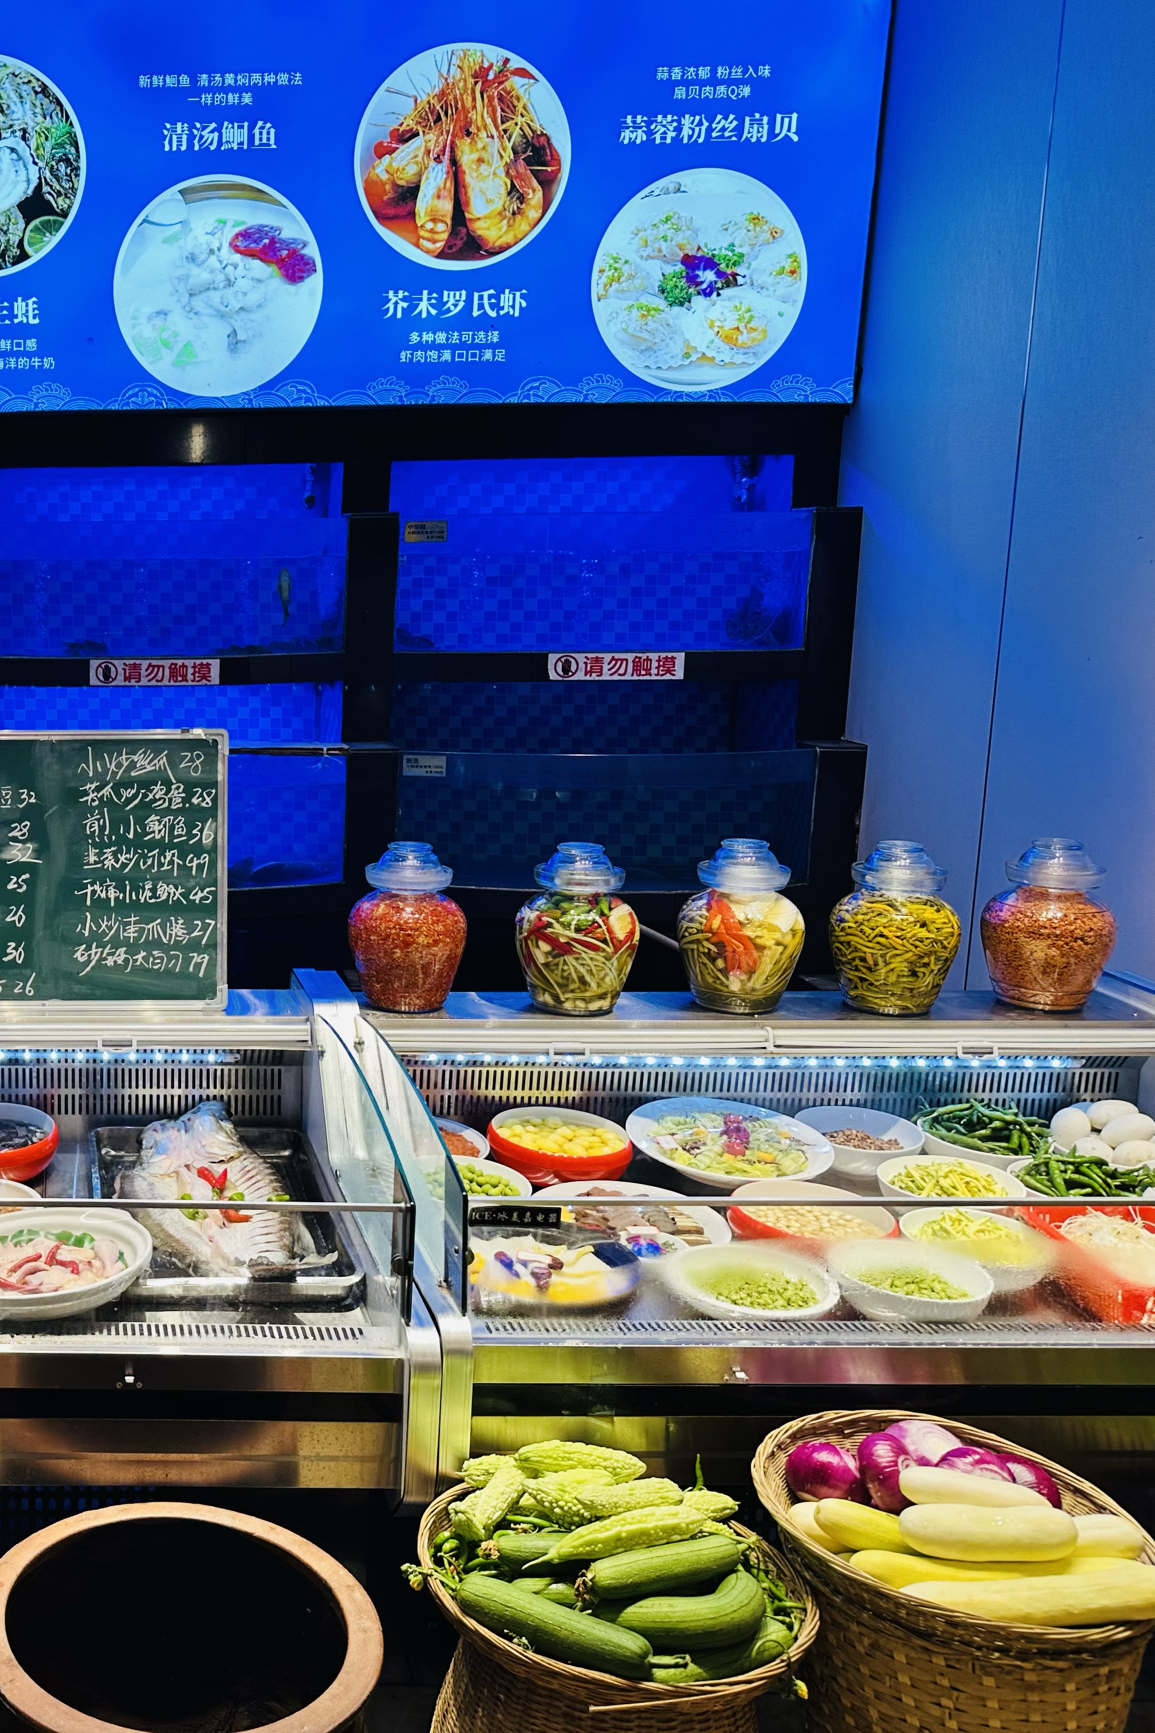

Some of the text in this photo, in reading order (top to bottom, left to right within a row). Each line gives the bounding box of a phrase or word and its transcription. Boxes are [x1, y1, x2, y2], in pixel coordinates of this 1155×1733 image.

[196, 71, 303, 87] 清汤黄焖两种做法
[655, 64, 771, 81] 蒜香浓郁 粉丝入味
[187, 91, 253, 106] 一样的鲜美
[673, 84, 751, 100] 扇贝肉质Q弹
[162, 120, 278, 152] 清汤鮰鱼
[619, 111, 799, 145] 蒜蓉粉丝扇贝
[381, 288, 528, 319] 芥末罗氏虾
[408, 330, 500, 345] 多种做法可选择
[399, 348, 506, 363] 虾肉饱满 口口满足
[122, 661, 211, 683] 请勿触摸
[583, 655, 676, 677] 请勿触摸
[180, 751, 204, 776] 28
[17, 789, 36, 808] 32
[8, 821, 31, 839] 28
[189, 818, 215, 844] 36
[7, 842, 43, 864] 32
[186, 854, 209, 877] 49
[7, 873, 30, 893] 25
[189, 887, 216, 903] 45
[5, 904, 26, 927] 26
[189, 920, 216, 945] 27
[189, 953, 210, 978] 79
[14, 972, 36, 996] 26
